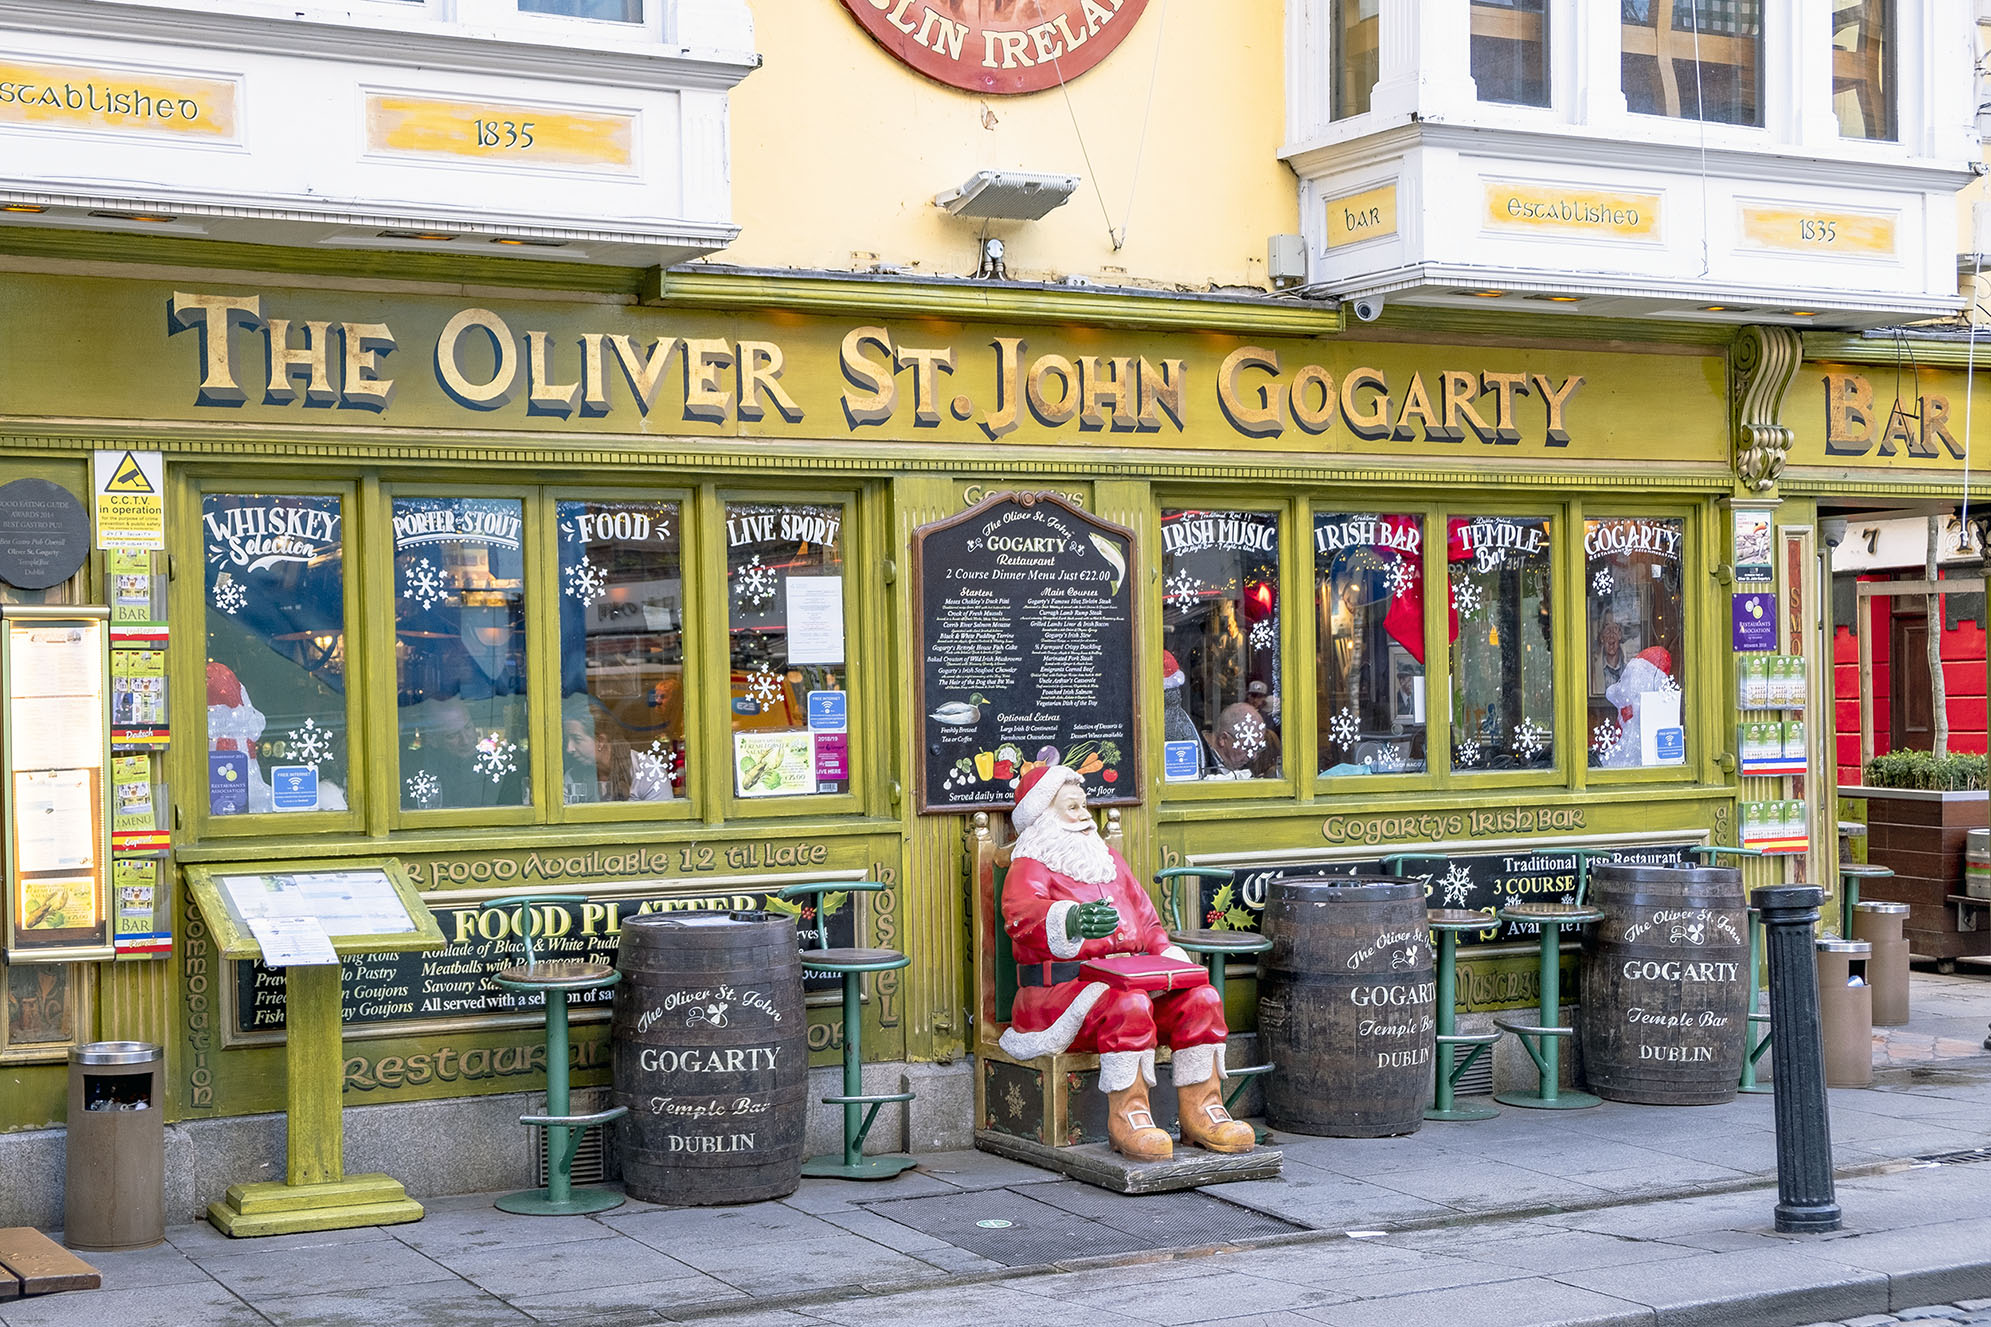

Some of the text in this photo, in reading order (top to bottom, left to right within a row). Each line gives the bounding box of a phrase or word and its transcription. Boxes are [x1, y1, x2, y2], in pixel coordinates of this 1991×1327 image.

[982, 0, 1125, 69] IRELA
[474, 119, 536, 150] 1835
[1507, 198, 1639, 227] established
[1800, 219, 1836, 244] 1835
[168, 290, 1587, 448] THE OLIVER ST. JOHN GOGARTY
[1823, 373, 1966, 460] BAR
[100, 505, 161, 515] in operation
[111, 496, 150, 504] C.C.T.V.
[203, 507, 341, 542] WHISKEY
[393, 511, 522, 540] PORTER STOUT
[575, 512, 650, 544] FOOD
[726, 514, 840, 547] LIVE SPORT
[982, 511, 1075, 541] The Oliver St. John
[1161, 519, 1275, 552] IRISH MUSIC
[986, 536, 1067, 553] GOGARTY
[1314, 521, 1420, 554] IRISH BAR
[1457, 524, 1542, 554] TEMPLE
[1584, 525, 1681, 555] GOGARTY
[1862, 528, 1881, 555] 7
[229, 534, 318, 566] Selection
[996, 554, 1055, 566] Restaurant
[1476, 547, 1507, 573] Bar
[946, 568, 1110, 581] 2 Course Dinner Menu Just €22.00
[960, 587, 993, 596] Starters
[1041, 587, 1098, 596] Main Courses
[119, 607, 147, 620] BAR
[997, 712, 1060, 723] Optional Extras
[1031, 724, 1058, 732] Continental
[949, 792, 974, 802] Served
[975, 791, 994, 802] daily
[1087, 786, 1115, 796] 2nd floor
[122, 816, 151, 827] MENU
[1322, 806, 1586, 844] Gogartys Irish Bar
[431, 841, 828, 890] FOOD Available 12 til late
[1503, 851, 1682, 873] Traditional Restaurant
[1494, 875, 1576, 895] 3 COURSE
[122, 918, 150, 932] BAR
[452, 905, 572, 944] FOOD
[1624, 909, 1740, 945] The Oliver St. John
[477, 936, 621, 958] of Blac & White Pudd
[1347, 947, 1375, 969] The
[1376, 931, 1411, 950] Oliver
[255, 968, 397, 987] Praw Pastry
[422, 960, 483, 976] Meatballs
[486, 960, 512, 972] with
[1623, 961, 1739, 982] GOGARTY
[354, 986, 408, 1000] Goujons
[423, 979, 475, 994] Savoury
[1455, 965, 1506, 1012] Music
[420, 990, 597, 1012] All served with a selon of
[637, 984, 782, 1034] The Oliver St. John
[254, 1002, 414, 1025] Fish Goujons
[1626, 1008, 1728, 1028] Temple Bar
[1359, 1019, 1417, 1038] Temple
[640, 1047, 781, 1073] GOGARTY
[1377, 1046, 1430, 1068] DUBLIN
[1638, 1045, 1712, 1062] DUBLIN
[651, 1097, 771, 1120] Temple Bar
[668, 1132, 756, 1153] DUBLIN
